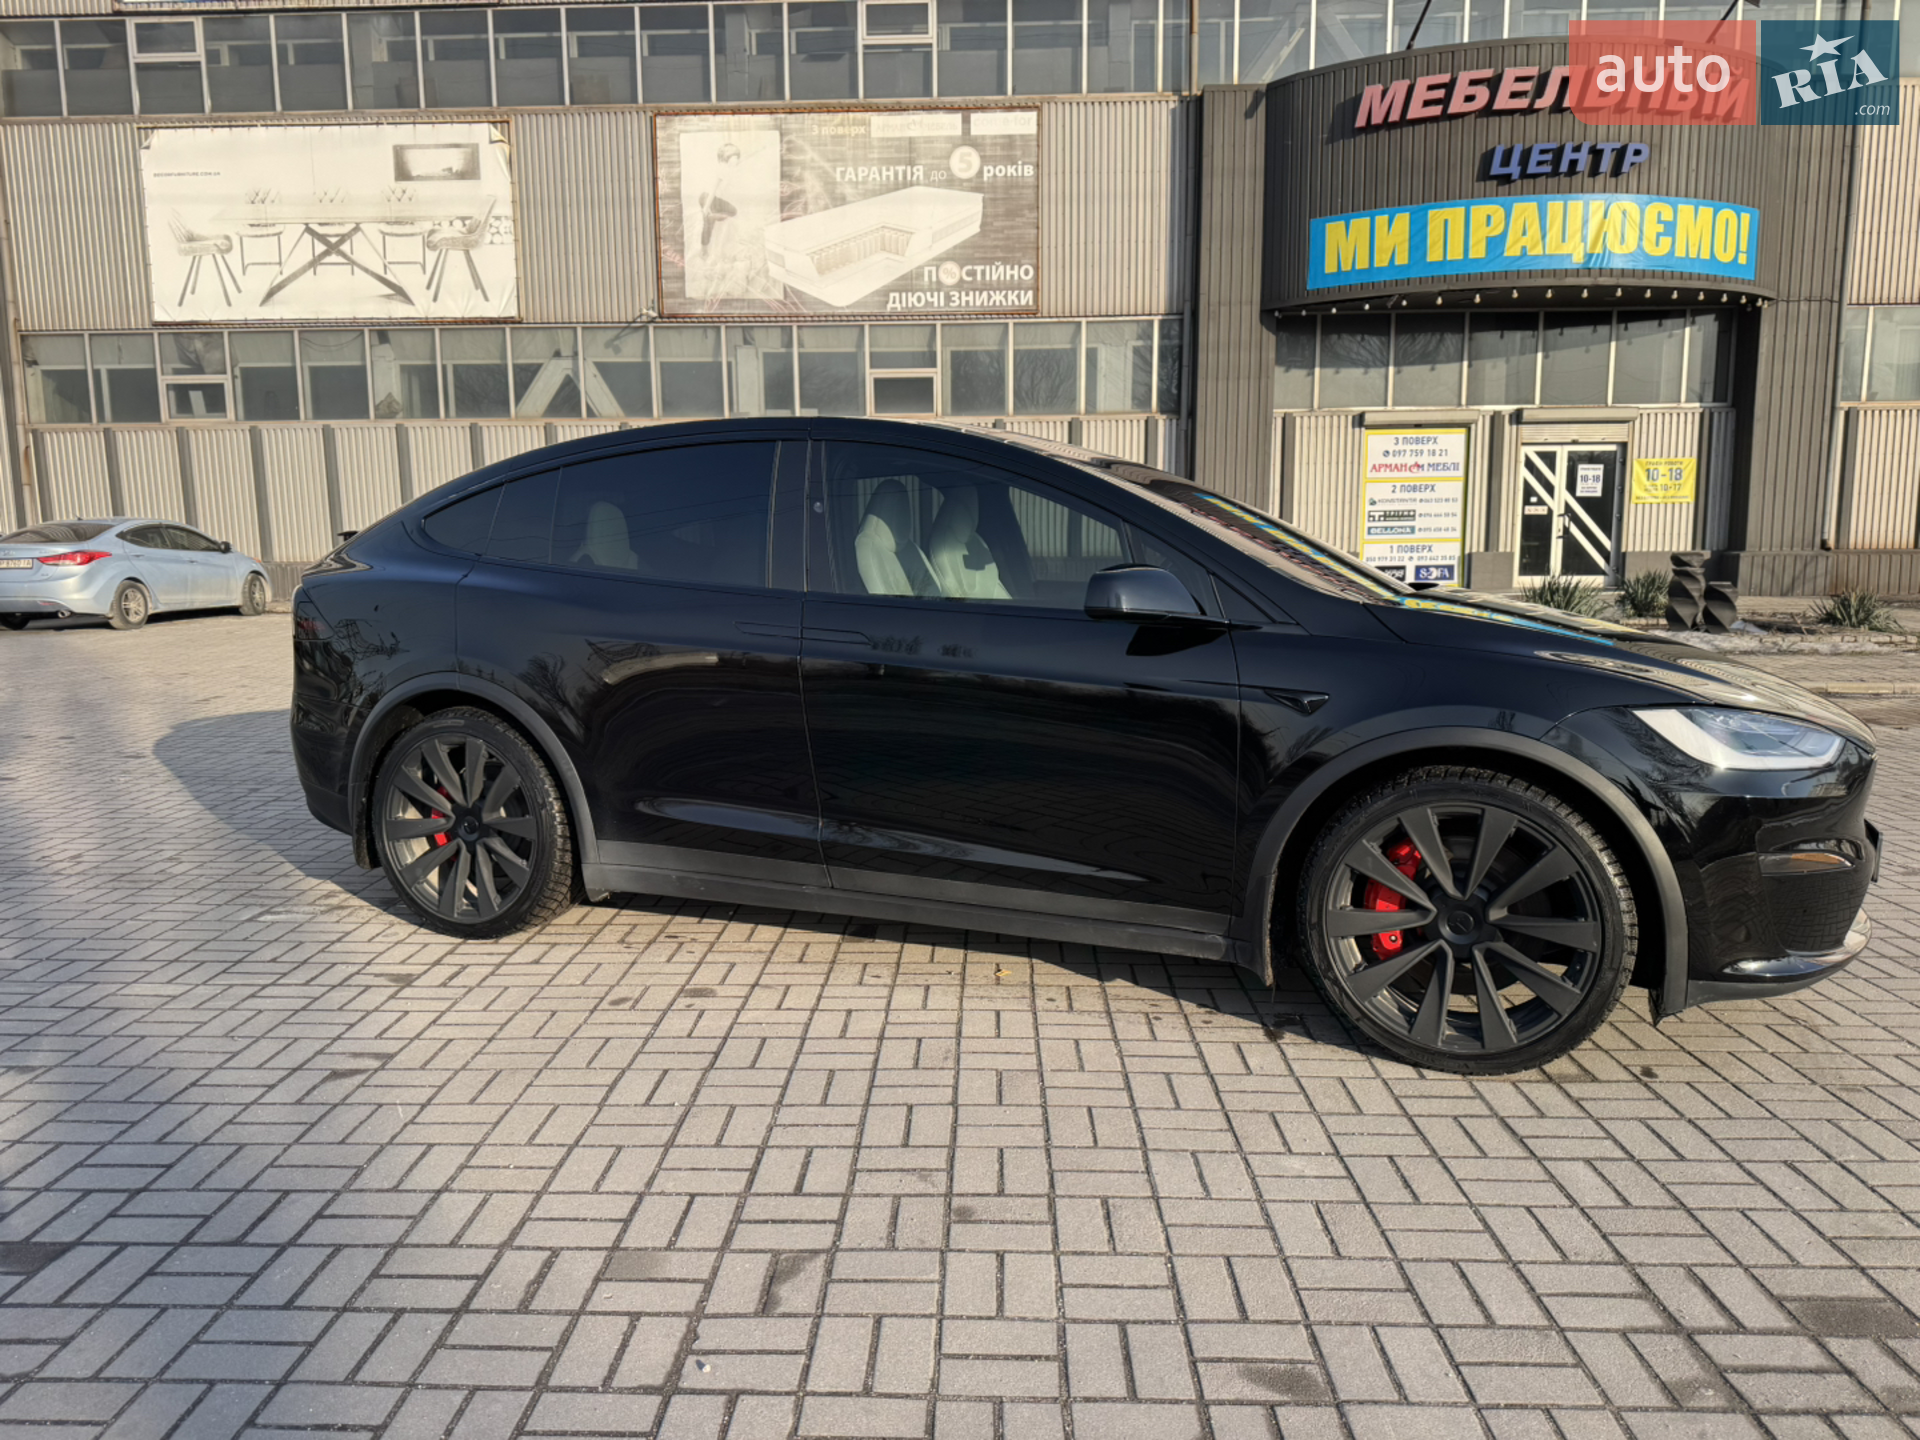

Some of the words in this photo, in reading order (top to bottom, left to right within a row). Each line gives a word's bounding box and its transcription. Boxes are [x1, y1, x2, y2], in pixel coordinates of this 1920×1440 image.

[821, 124, 868, 137] поверх
[1489, 141, 1650, 180] ЦЕНТР
[835, 165, 924, 182] ГАРАНТІЯ
[930, 170, 947, 182] до
[957, 152, 973, 172] 5
[983, 160, 1034, 182] років
[1324, 212, 1411, 274] МИ
[1426, 200, 1751, 265] ПРАЦЮЄМО!
[887, 291, 945, 311] ДІЮЧІ
[949, 290, 1034, 307] ЗНИЖКИ
[1393, 436, 1399, 446] 3
[1402, 436, 1439, 446] ПОВЕРХ
[1392, 449, 1407, 457] 097
[1409, 449, 1424, 457] 759
[1427, 449, 1436, 457] 18
[1370, 463, 1408, 473] АРМАН
[1427, 462, 1460, 472] МЕБЛІ
[1580, 474, 1601, 483] 10-18
[1391, 484, 1397, 493] 2
[1400, 483, 1436, 493] ПОВЕРХ
[1397, 544, 1433, 554] ПОВЕРХ
